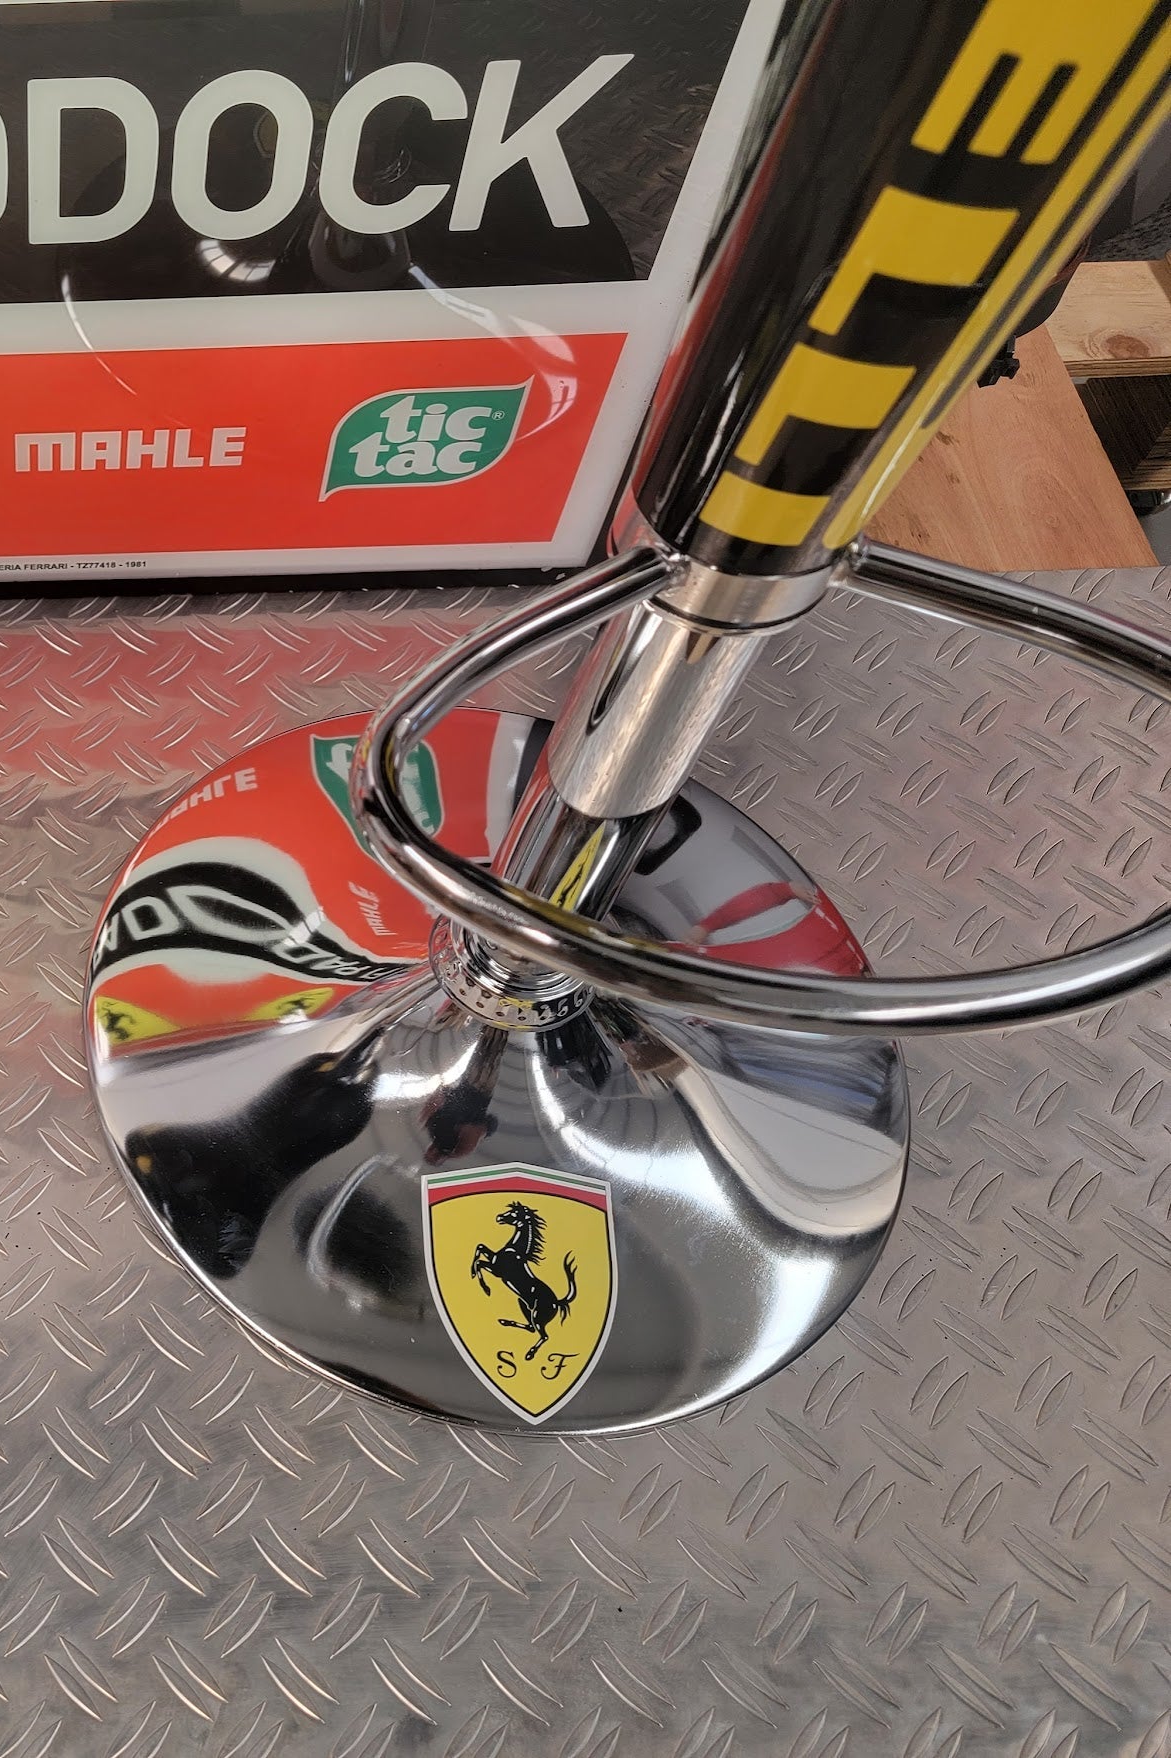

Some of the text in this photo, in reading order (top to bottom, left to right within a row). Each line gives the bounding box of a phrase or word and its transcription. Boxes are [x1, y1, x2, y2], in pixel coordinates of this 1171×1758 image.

[379, 395, 493, 444] tic
[15, 427, 247, 472] MAHLE
[348, 431, 483, 478] tac
[24, 563, 68, 571] FERRARI
[77, 561, 116, 569] TZ77418
[496, 1350, 518, 1379] S
